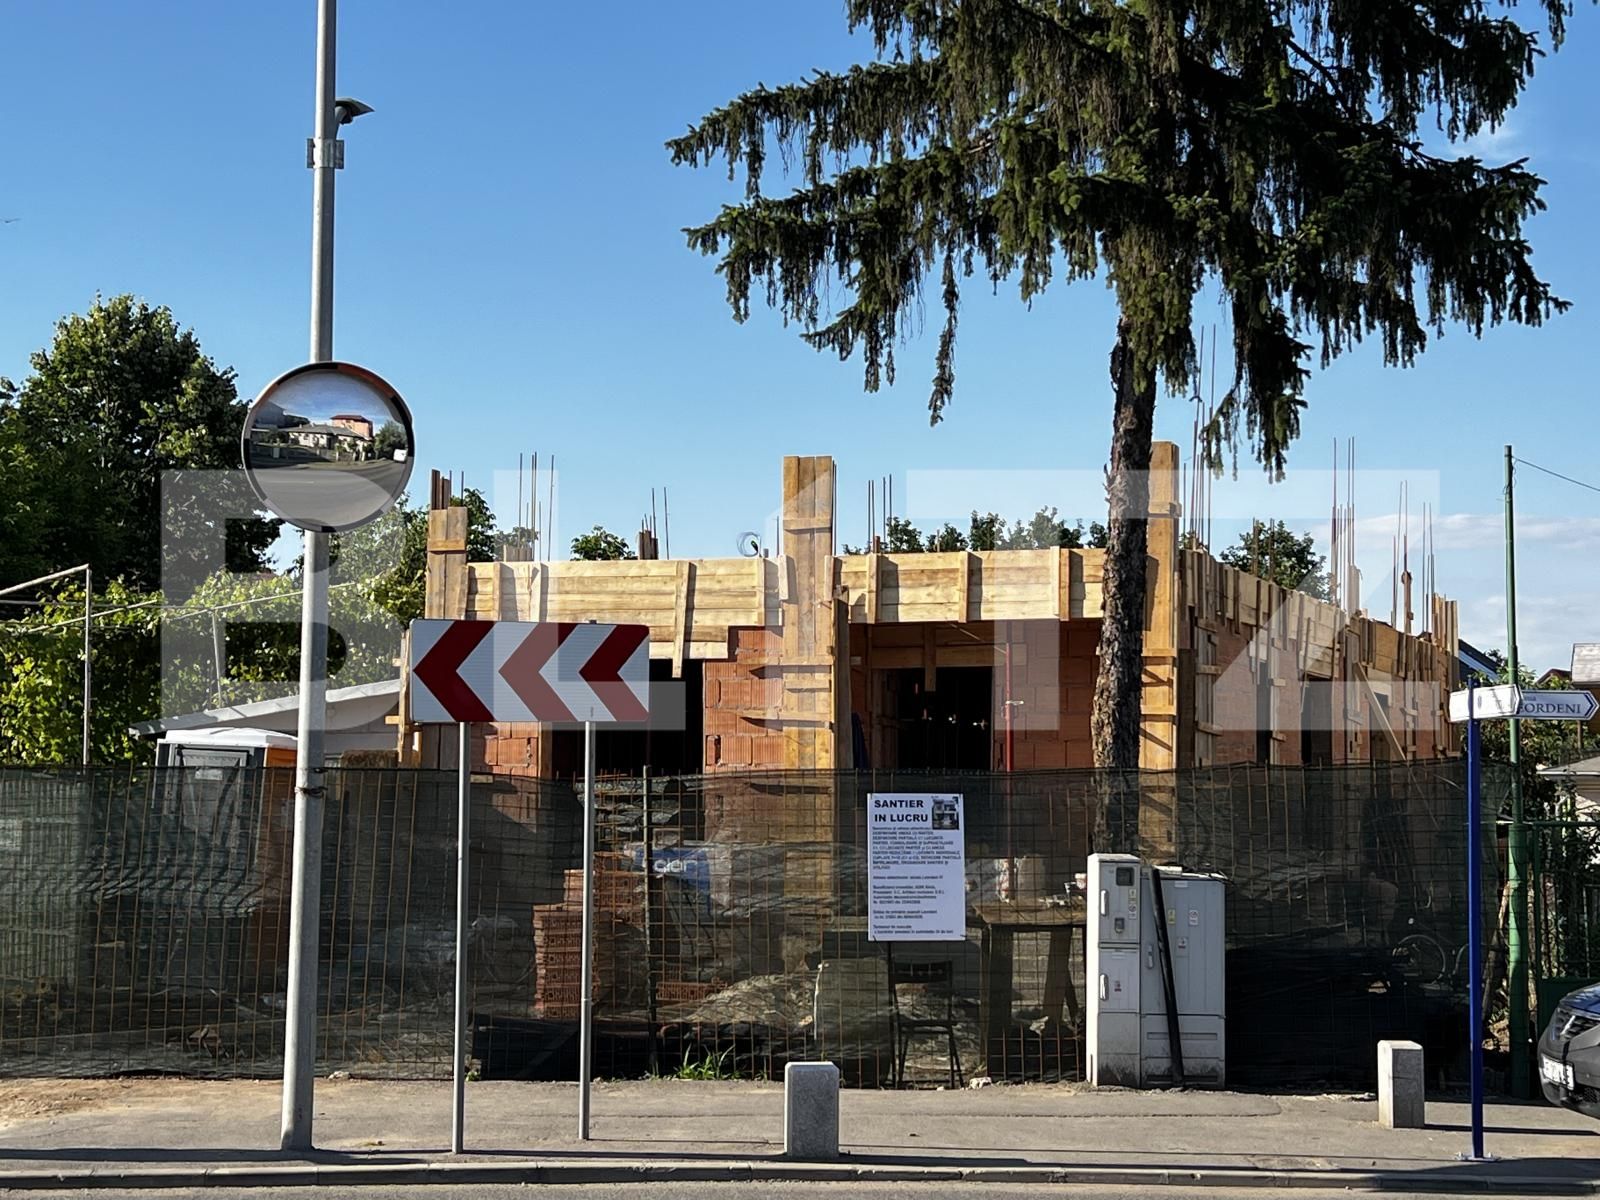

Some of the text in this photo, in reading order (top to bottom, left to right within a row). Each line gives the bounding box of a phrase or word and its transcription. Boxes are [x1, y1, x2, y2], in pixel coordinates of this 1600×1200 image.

[1519, 703, 1581, 714] EORDENI
[874, 799, 924, 809] SANTIER
[874, 814, 928, 822] IN LUCRU
